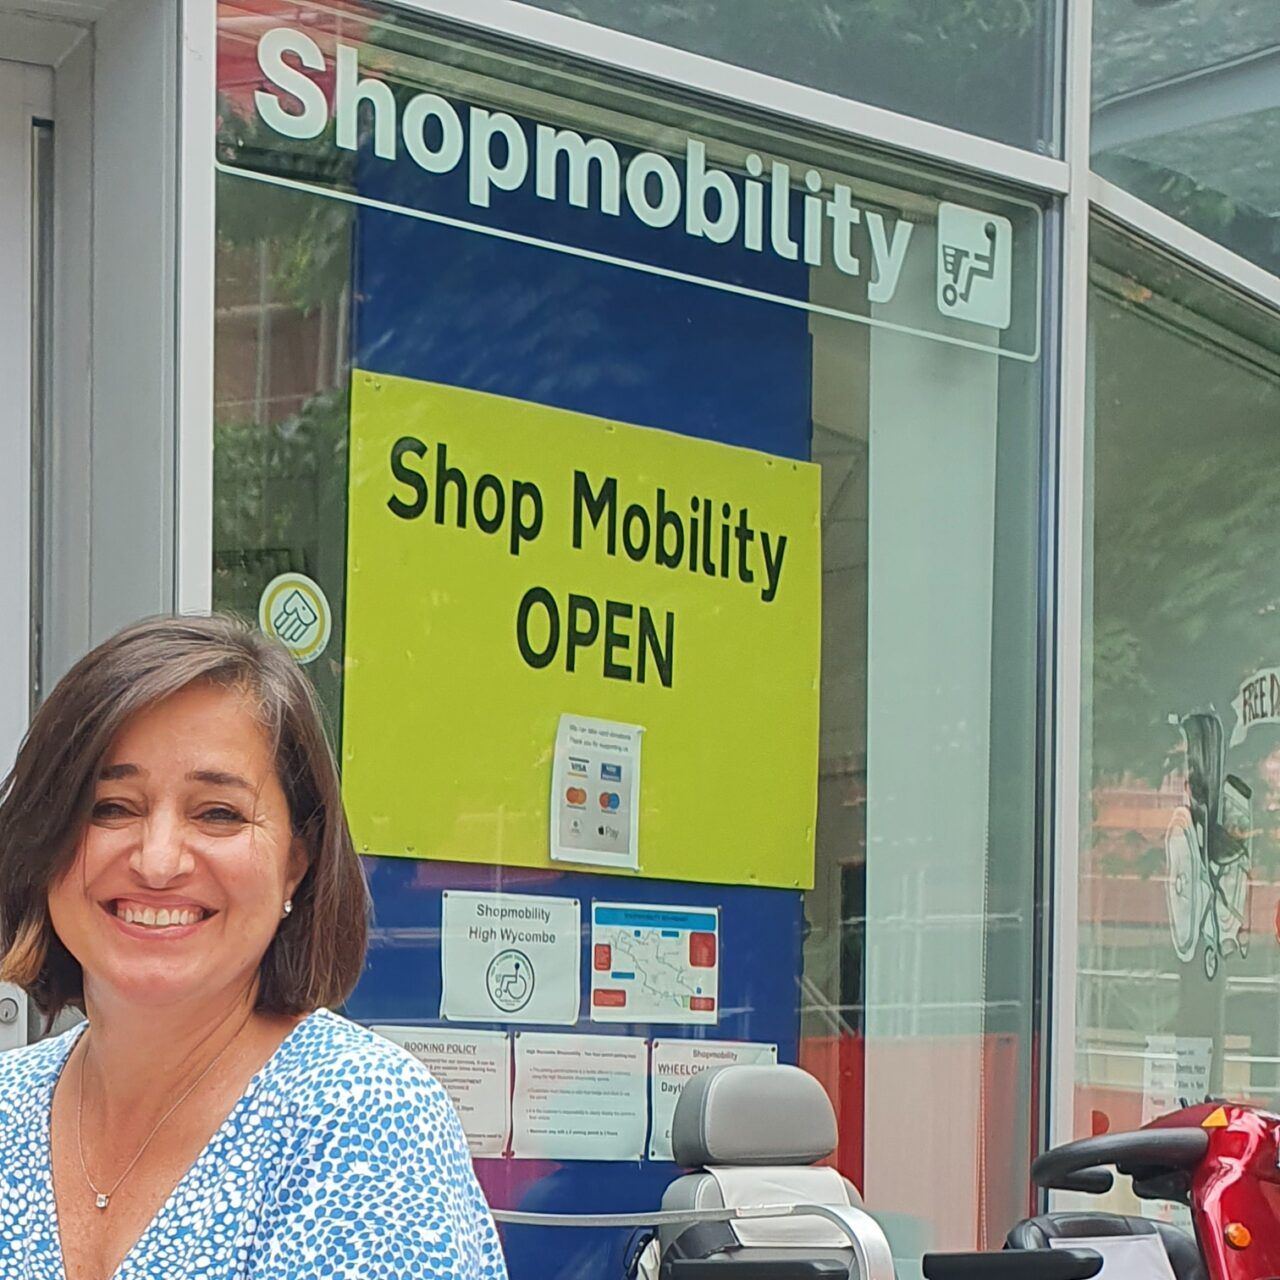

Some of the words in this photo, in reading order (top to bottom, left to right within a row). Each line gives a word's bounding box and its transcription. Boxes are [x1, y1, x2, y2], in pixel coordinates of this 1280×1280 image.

[254, 28, 913, 304] Shopmobility
[387, 436, 544, 556] Shop
[572, 470, 788, 602] Mobility
[517, 586, 675, 688] OPEN
[1243, 676, 1268, 726] FREE
[477, 903, 551, 924] Shopmobility
[469, 926, 497, 943] High
[500, 928, 556, 944] Wycombe
[403, 1041, 445, 1053] BOOKING
[447, 1043, 477, 1054] POLICY
[693, 1049, 738, 1061] Shopmobility
